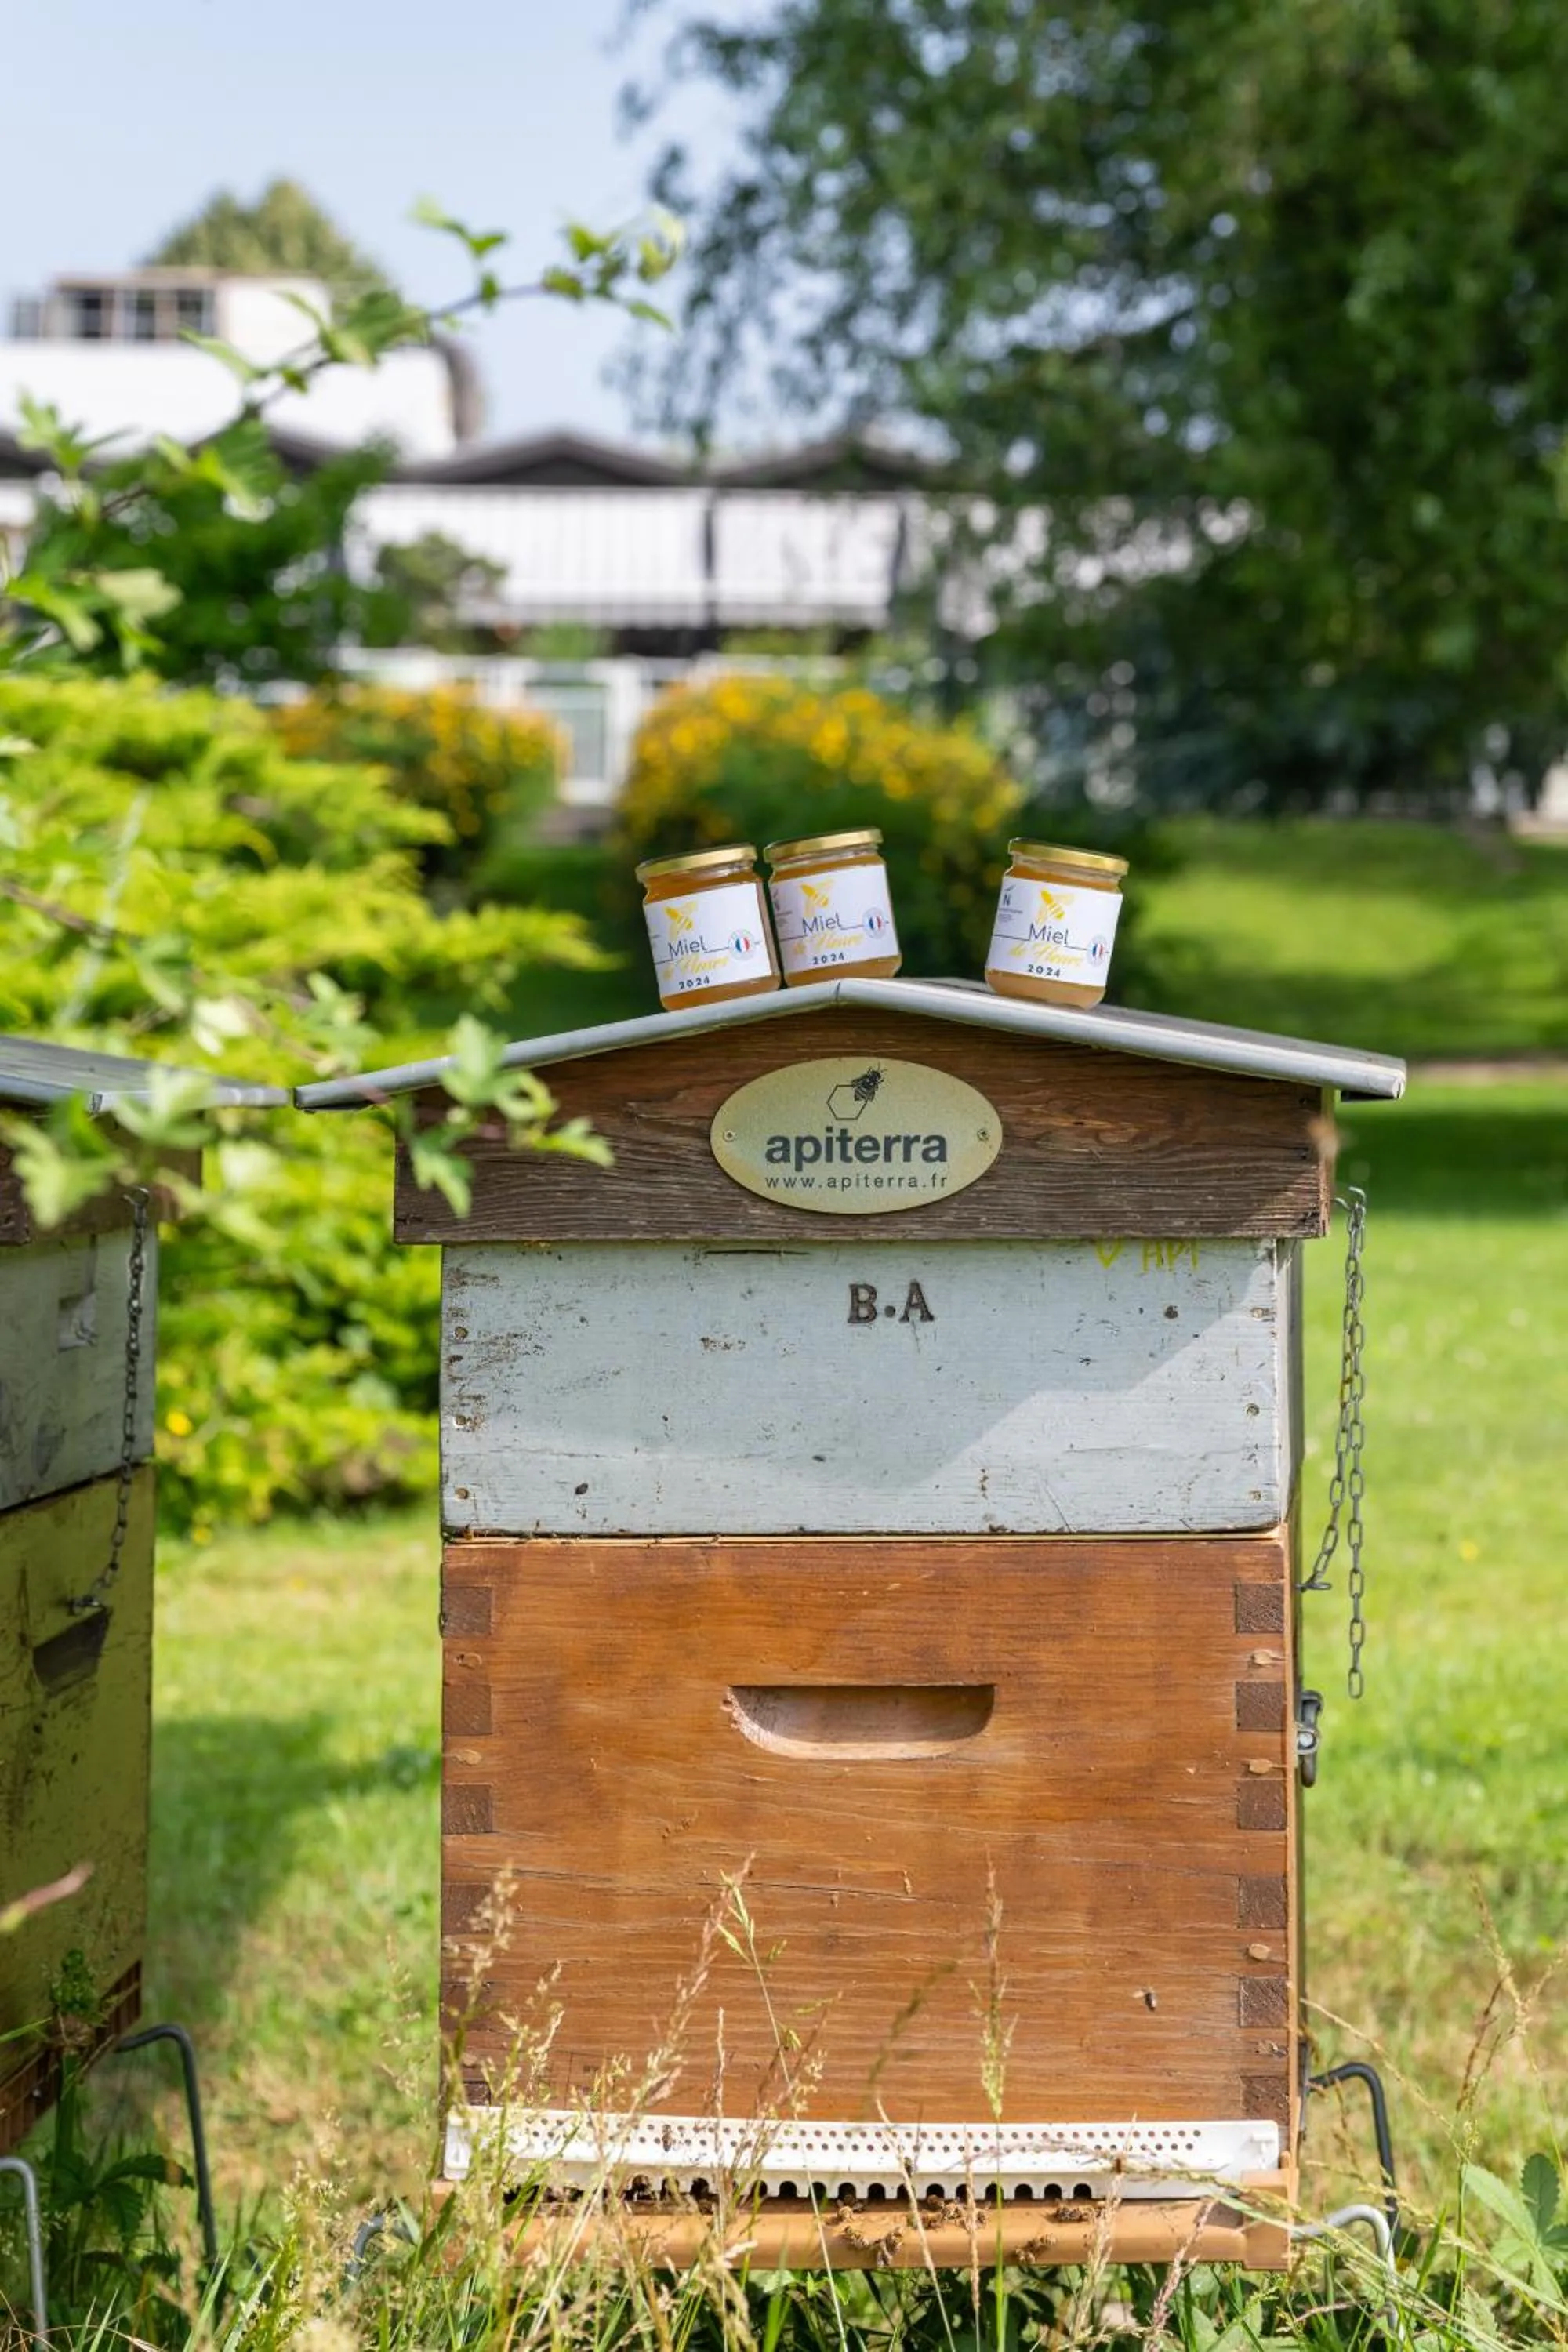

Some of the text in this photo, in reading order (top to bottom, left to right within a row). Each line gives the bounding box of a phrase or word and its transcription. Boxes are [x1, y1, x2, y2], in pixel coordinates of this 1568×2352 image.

[801, 911, 843, 935] Miel
[1029, 922, 1069, 944] Miel
[667, 935, 707, 959] Miel
[812, 951, 845, 965] 2024
[1027, 964, 1062, 978] 2024
[678, 975, 710, 990] 2024
[764, 1126, 947, 1171] apiterra
[765, 1174, 948, 1192] www.apiterra.fr
